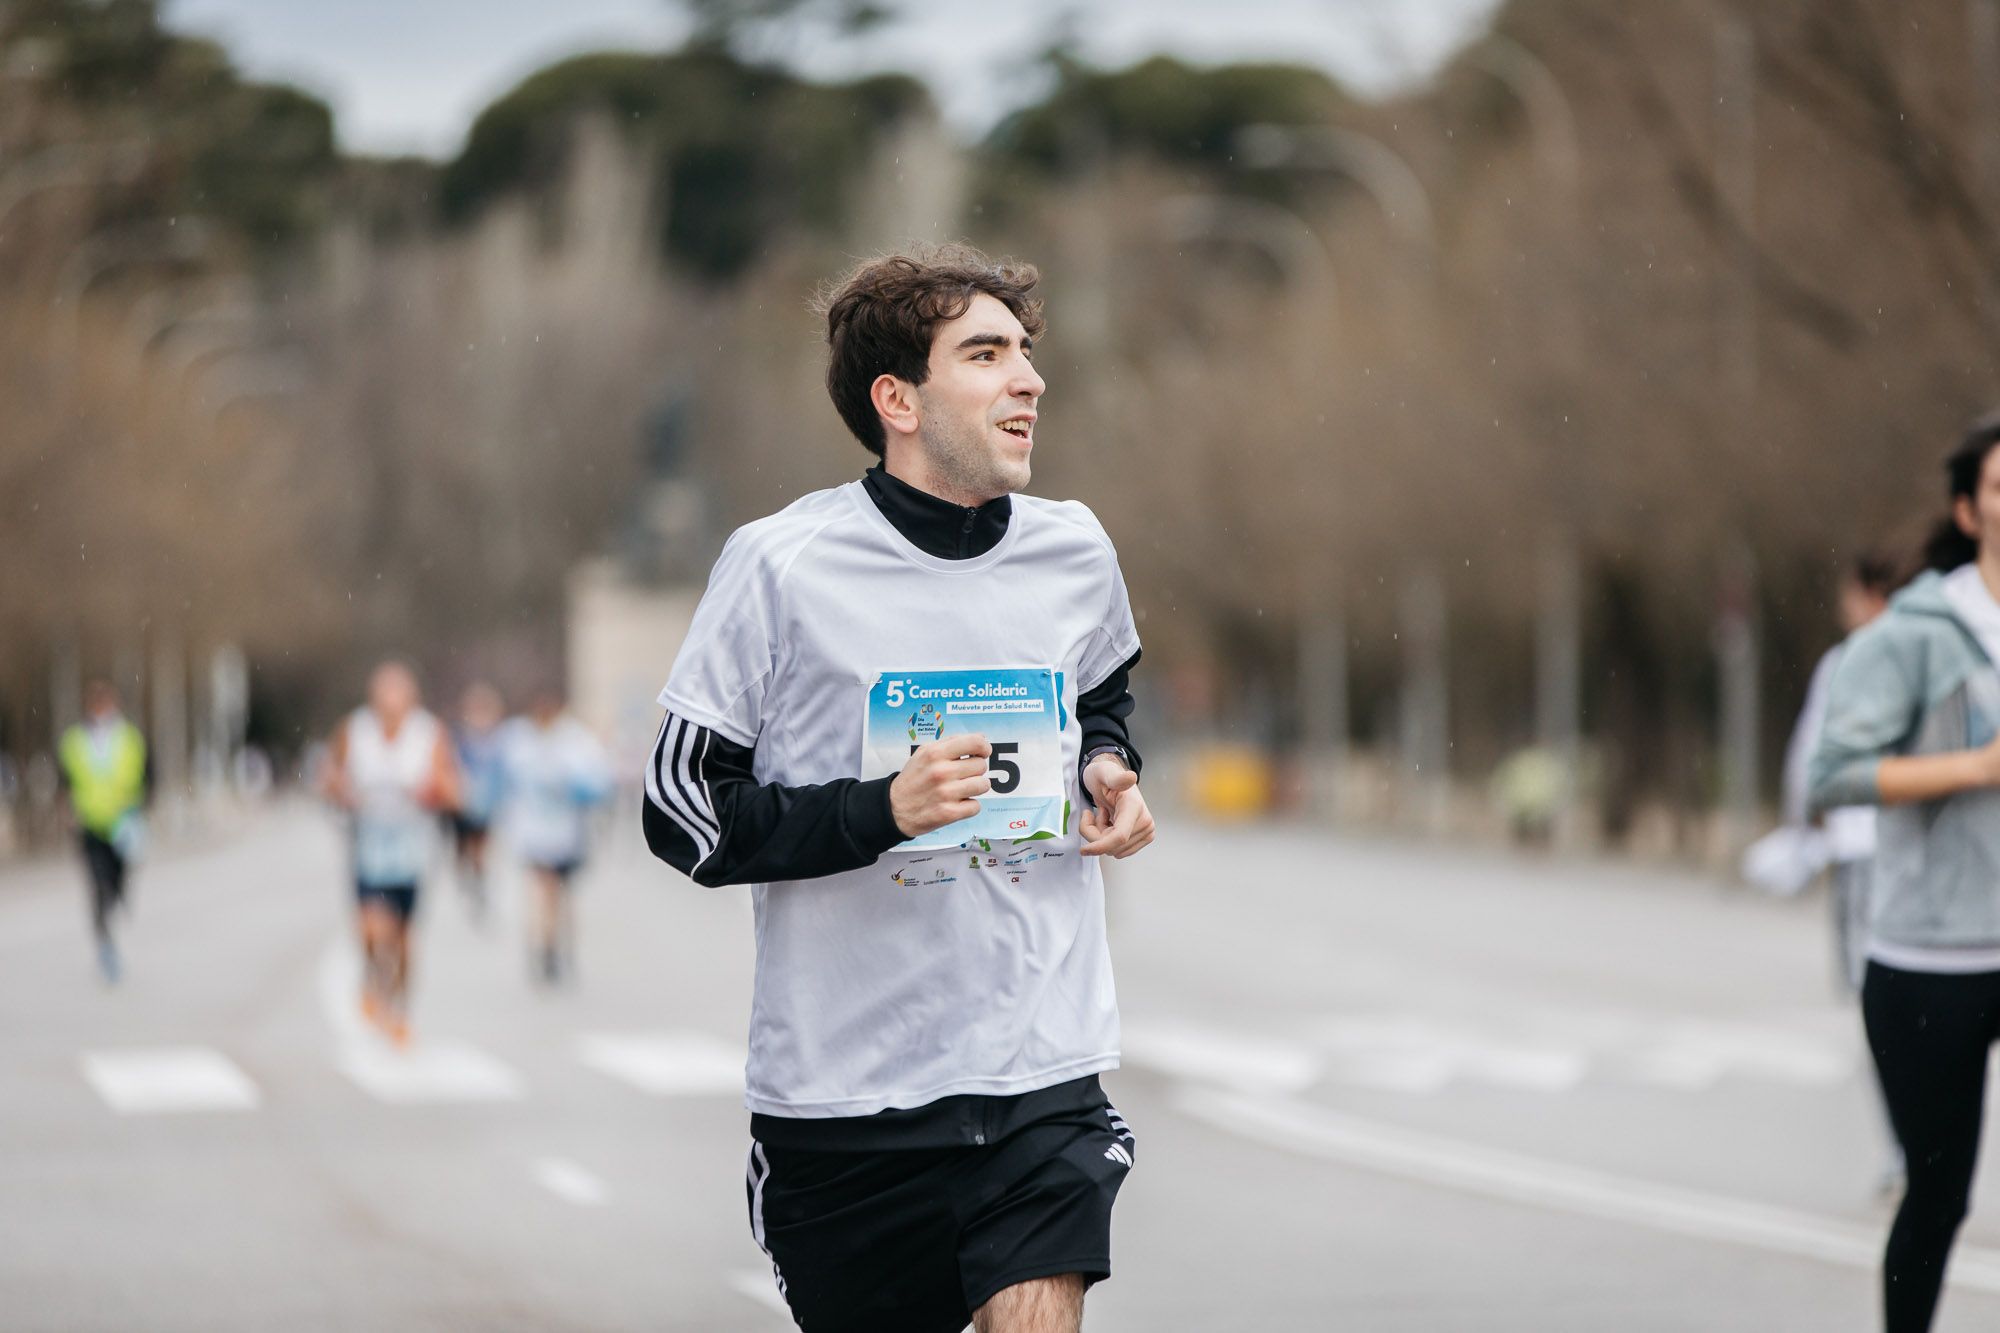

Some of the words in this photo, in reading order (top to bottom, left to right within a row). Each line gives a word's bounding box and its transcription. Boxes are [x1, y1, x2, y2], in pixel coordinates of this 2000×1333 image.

[909, 685, 964, 699] Carrera
[967, 682, 1028, 697] Solidaria
[951, 703, 981, 711] Muévete
[1009, 820, 1029, 830] CSL
